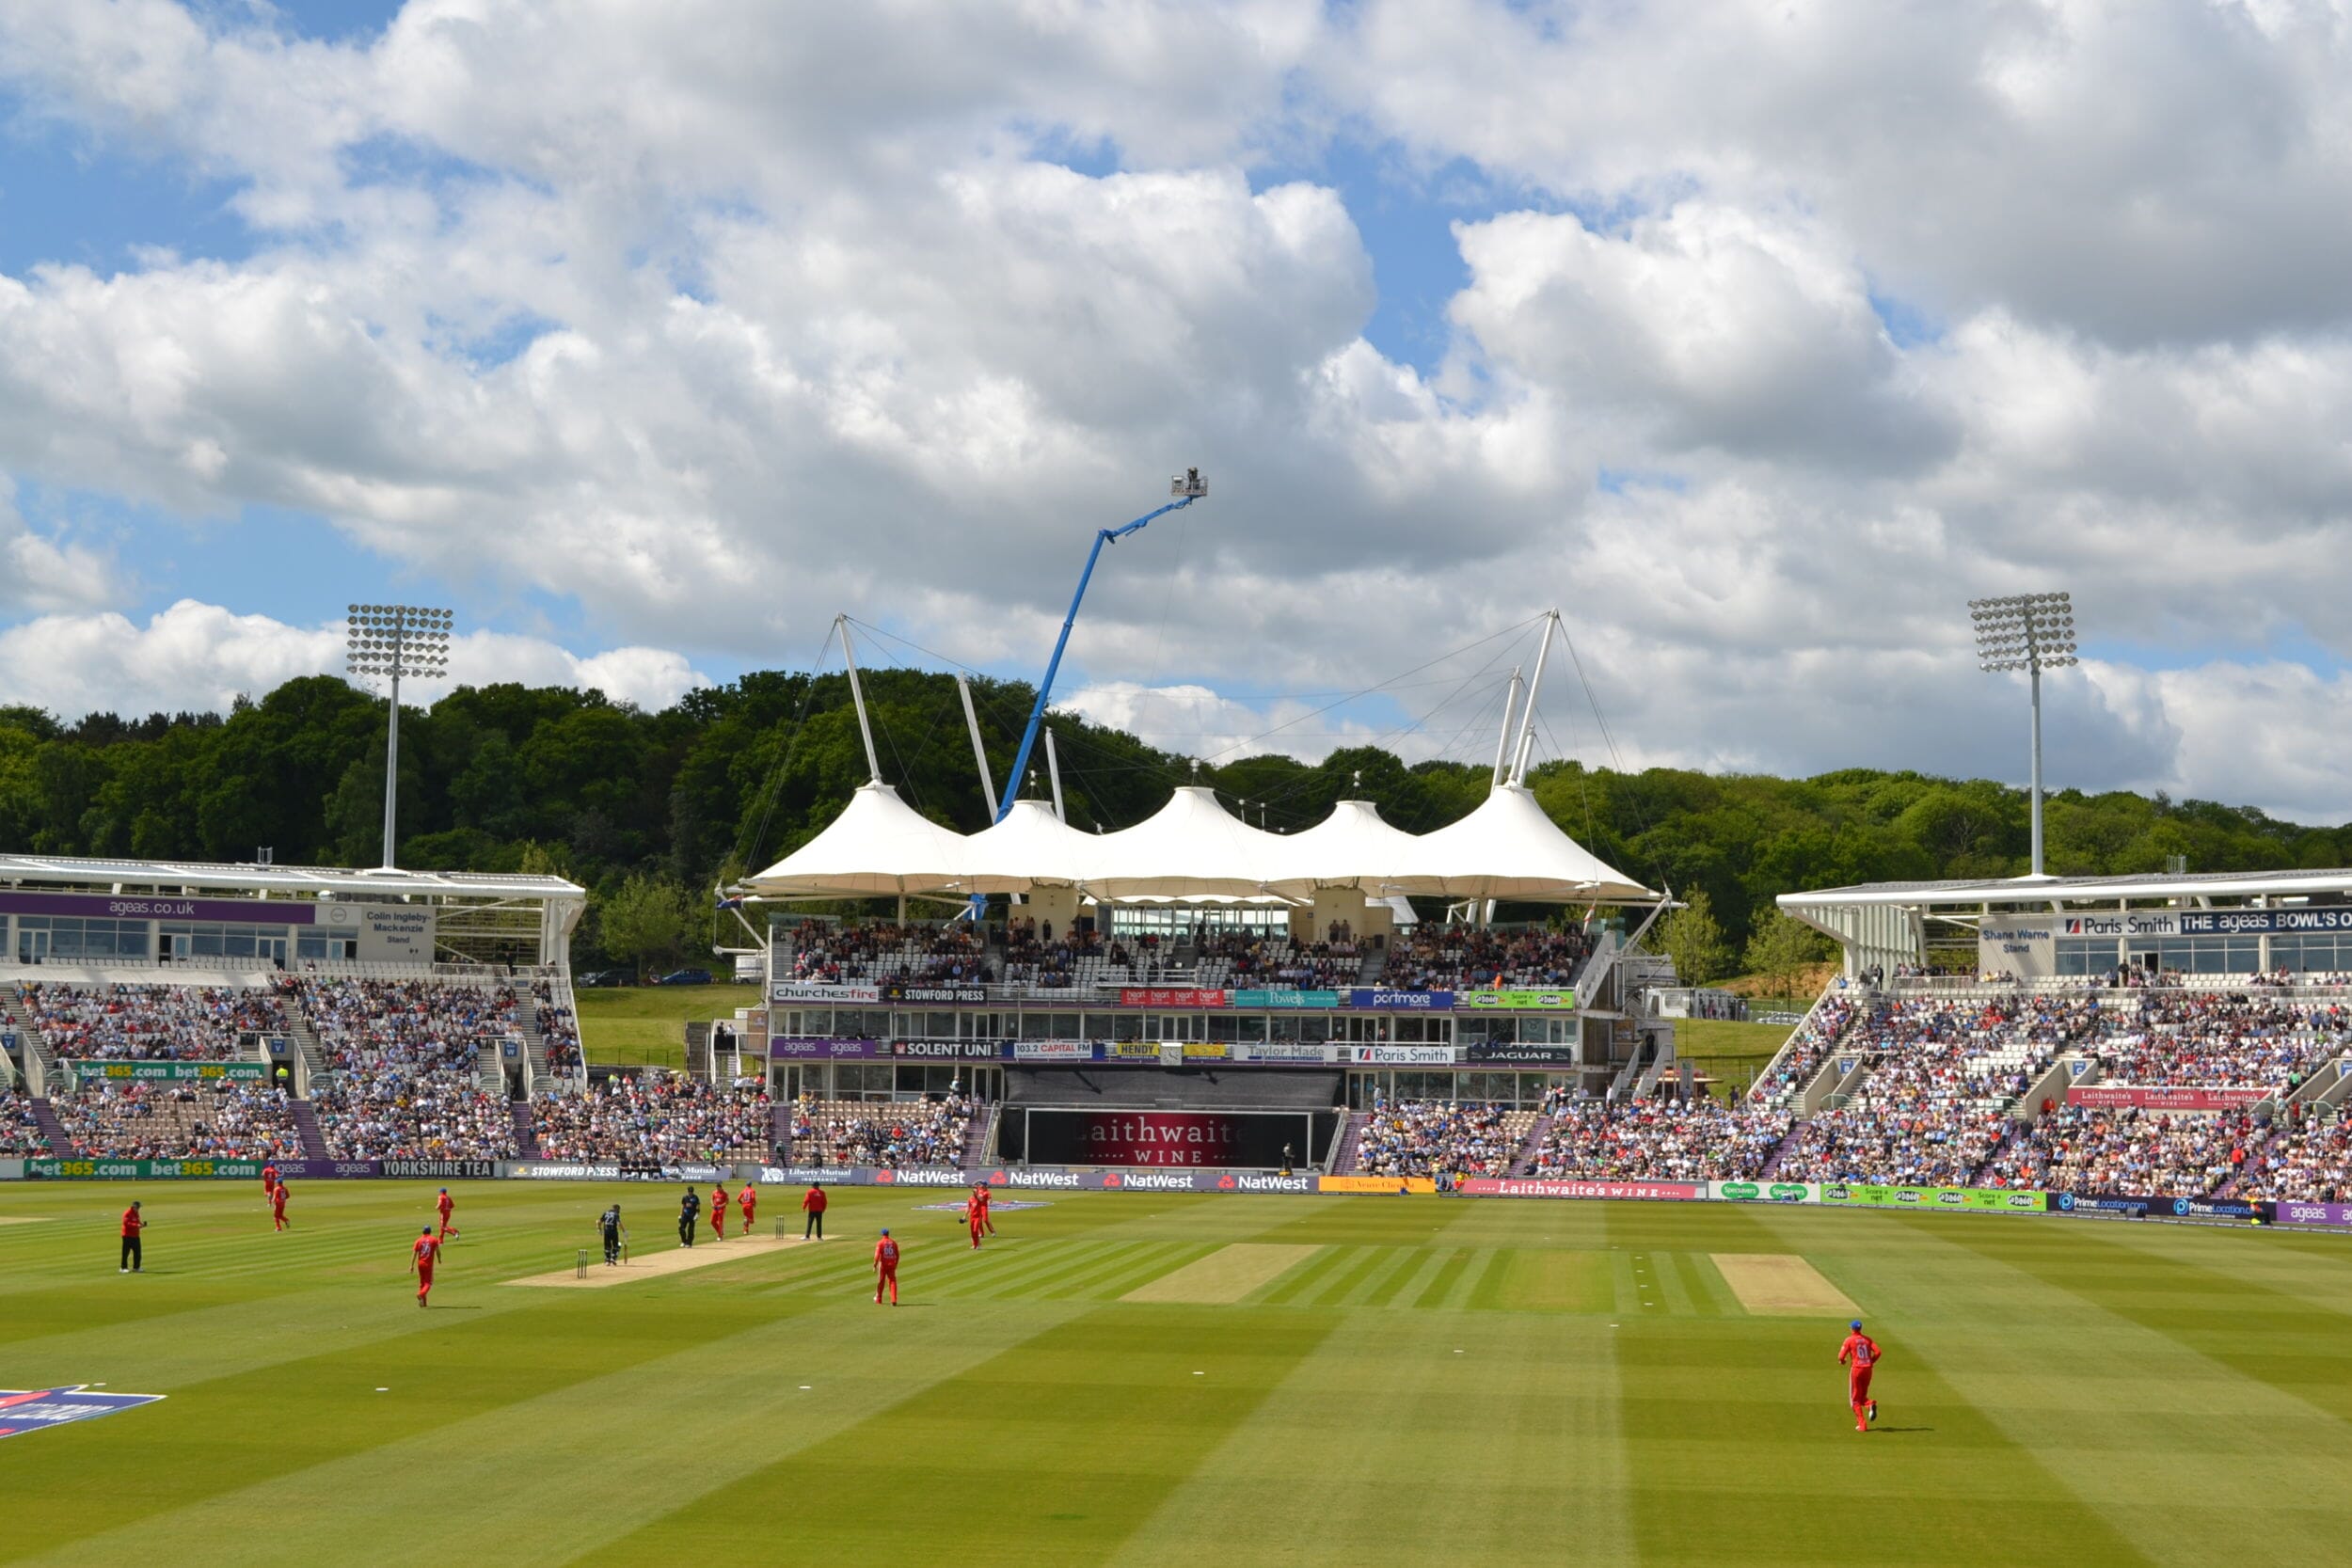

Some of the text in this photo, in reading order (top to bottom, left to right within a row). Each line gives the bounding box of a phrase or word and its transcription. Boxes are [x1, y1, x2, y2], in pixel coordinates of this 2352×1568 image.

[109, 900, 195, 916] ageas.co.uk
[367, 911, 432, 923] Colin Ingleby-
[2183, 915, 2213, 930] THE
[2219, 914, 2269, 933] ageas
[2276, 912, 2337, 928] BOWL'S
[373, 923, 424, 933] Mackenzie
[2085, 916, 2174, 934] Paris Smith
[387, 936, 411, 944] Stand
[1983, 928, 2050, 941] Shane Warne
[2003, 943, 2030, 953] Stand
[776, 988, 877, 1000] churchesfire
[905, 990, 984, 1002] STOWFORD PRESS
[1374, 992, 1431, 1007] portmore
[785, 1041, 817, 1053] ageas
[831, 1042, 863, 1054] ageas
[908, 1042, 992, 1056] SOLENT UNI
[1016, 1043, 1091, 1053] 103.2 CAPITAL FM
[1120, 1044, 1153, 1054] HENDY
[1248, 1046, 1325, 1057] Taylor Made
[1375, 1048, 1448, 1062] Paris Smith
[1486, 1052, 1551, 1060] JAGUAR
[81, 1064, 167, 1078] bet365.com
[174, 1064, 261, 1079] bet365.com
[1135, 1150, 1202, 1163] WINE
[30, 1161, 136, 1176] bet365.com
[151, 1162, 256, 1176] bet365.com
[335, 1163, 371, 1177] ageas
[383, 1161, 491, 1176] YORKSHIRE TEA
[532, 1166, 618, 1177] STOWFORD PRESS
[789, 1168, 818, 1177] Liberty
[897, 1171, 965, 1184] NatWest
[1009, 1172, 1079, 1185] NatWest
[1123, 1174, 1193, 1188] NatWest
[1238, 1176, 1308, 1190] NatWest
[1499, 1181, 1658, 1197] Laithwaite's WINE
[2291, 1207, 2326, 1222] ageas
